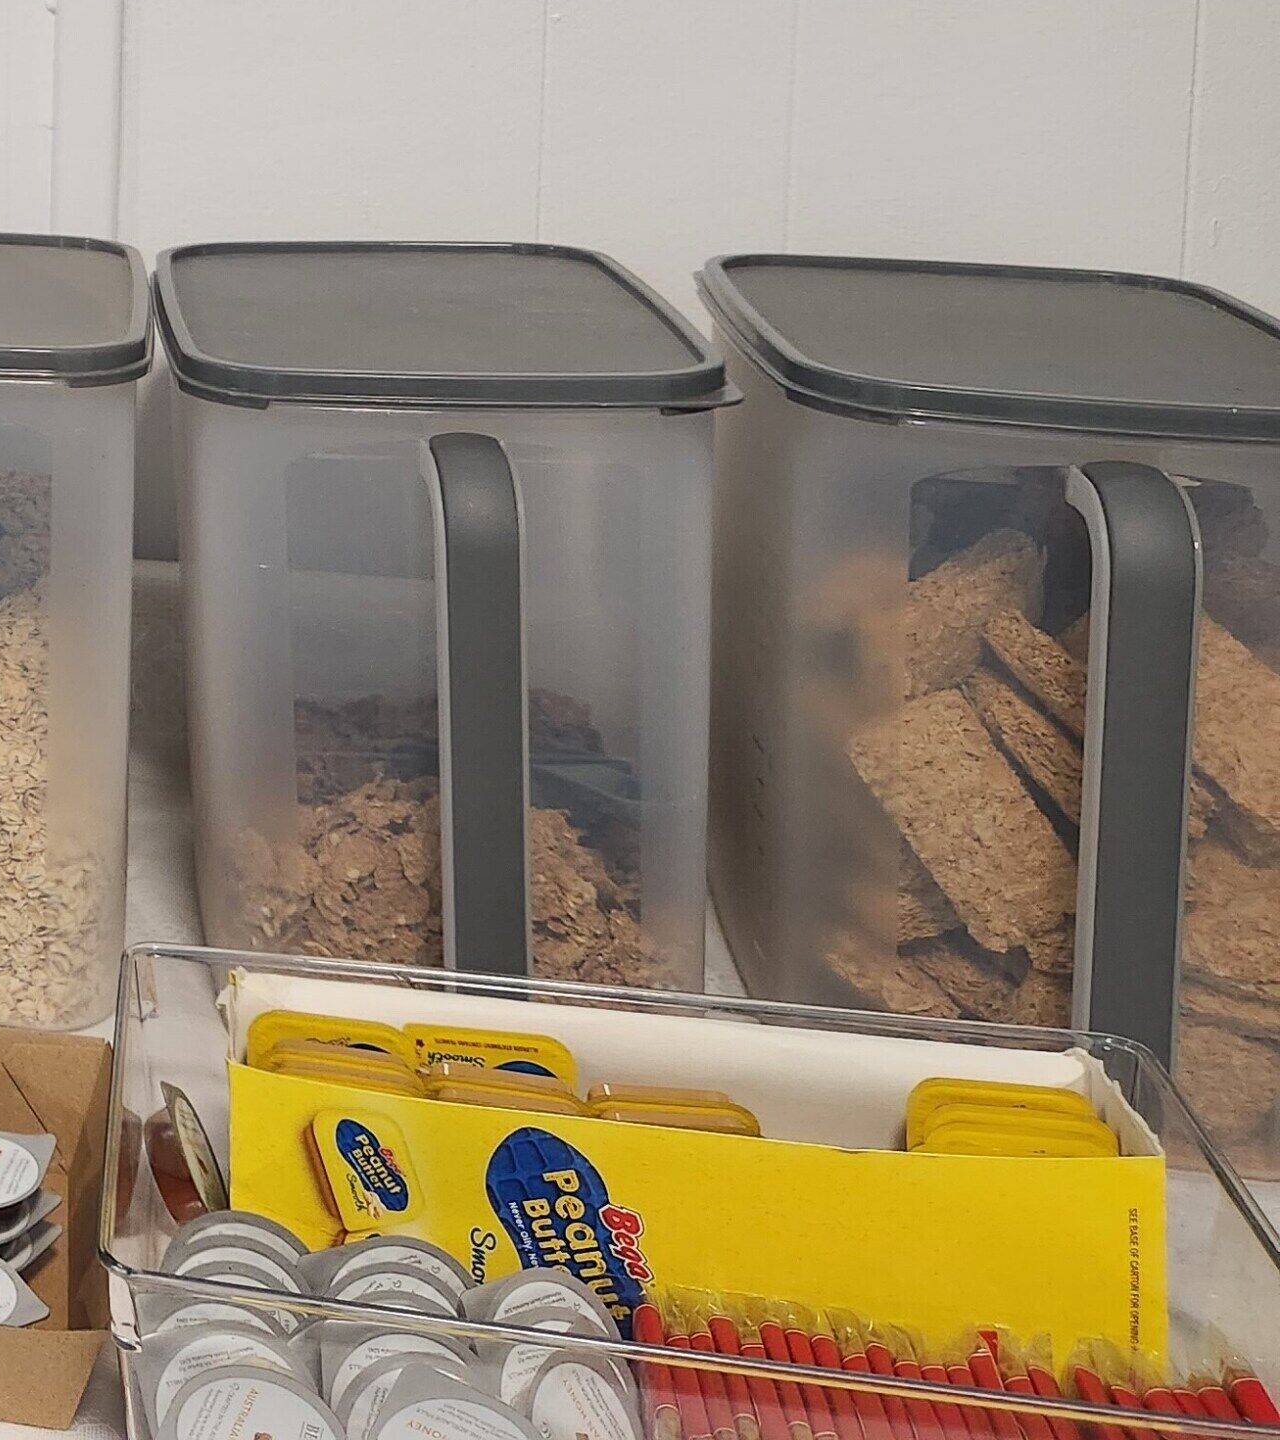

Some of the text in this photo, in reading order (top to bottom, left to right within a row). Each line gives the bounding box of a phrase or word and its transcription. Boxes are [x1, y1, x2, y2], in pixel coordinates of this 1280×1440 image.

[352, 1134, 401, 1194] Peanut Butter
[522, 1198, 572, 1276] Butt
[542, 1169, 632, 1320] Peanut
[599, 1204, 654, 1282] Bega
[1129, 1208, 1139, 1348] SEE BASE OF CARTON FOR OPENING
